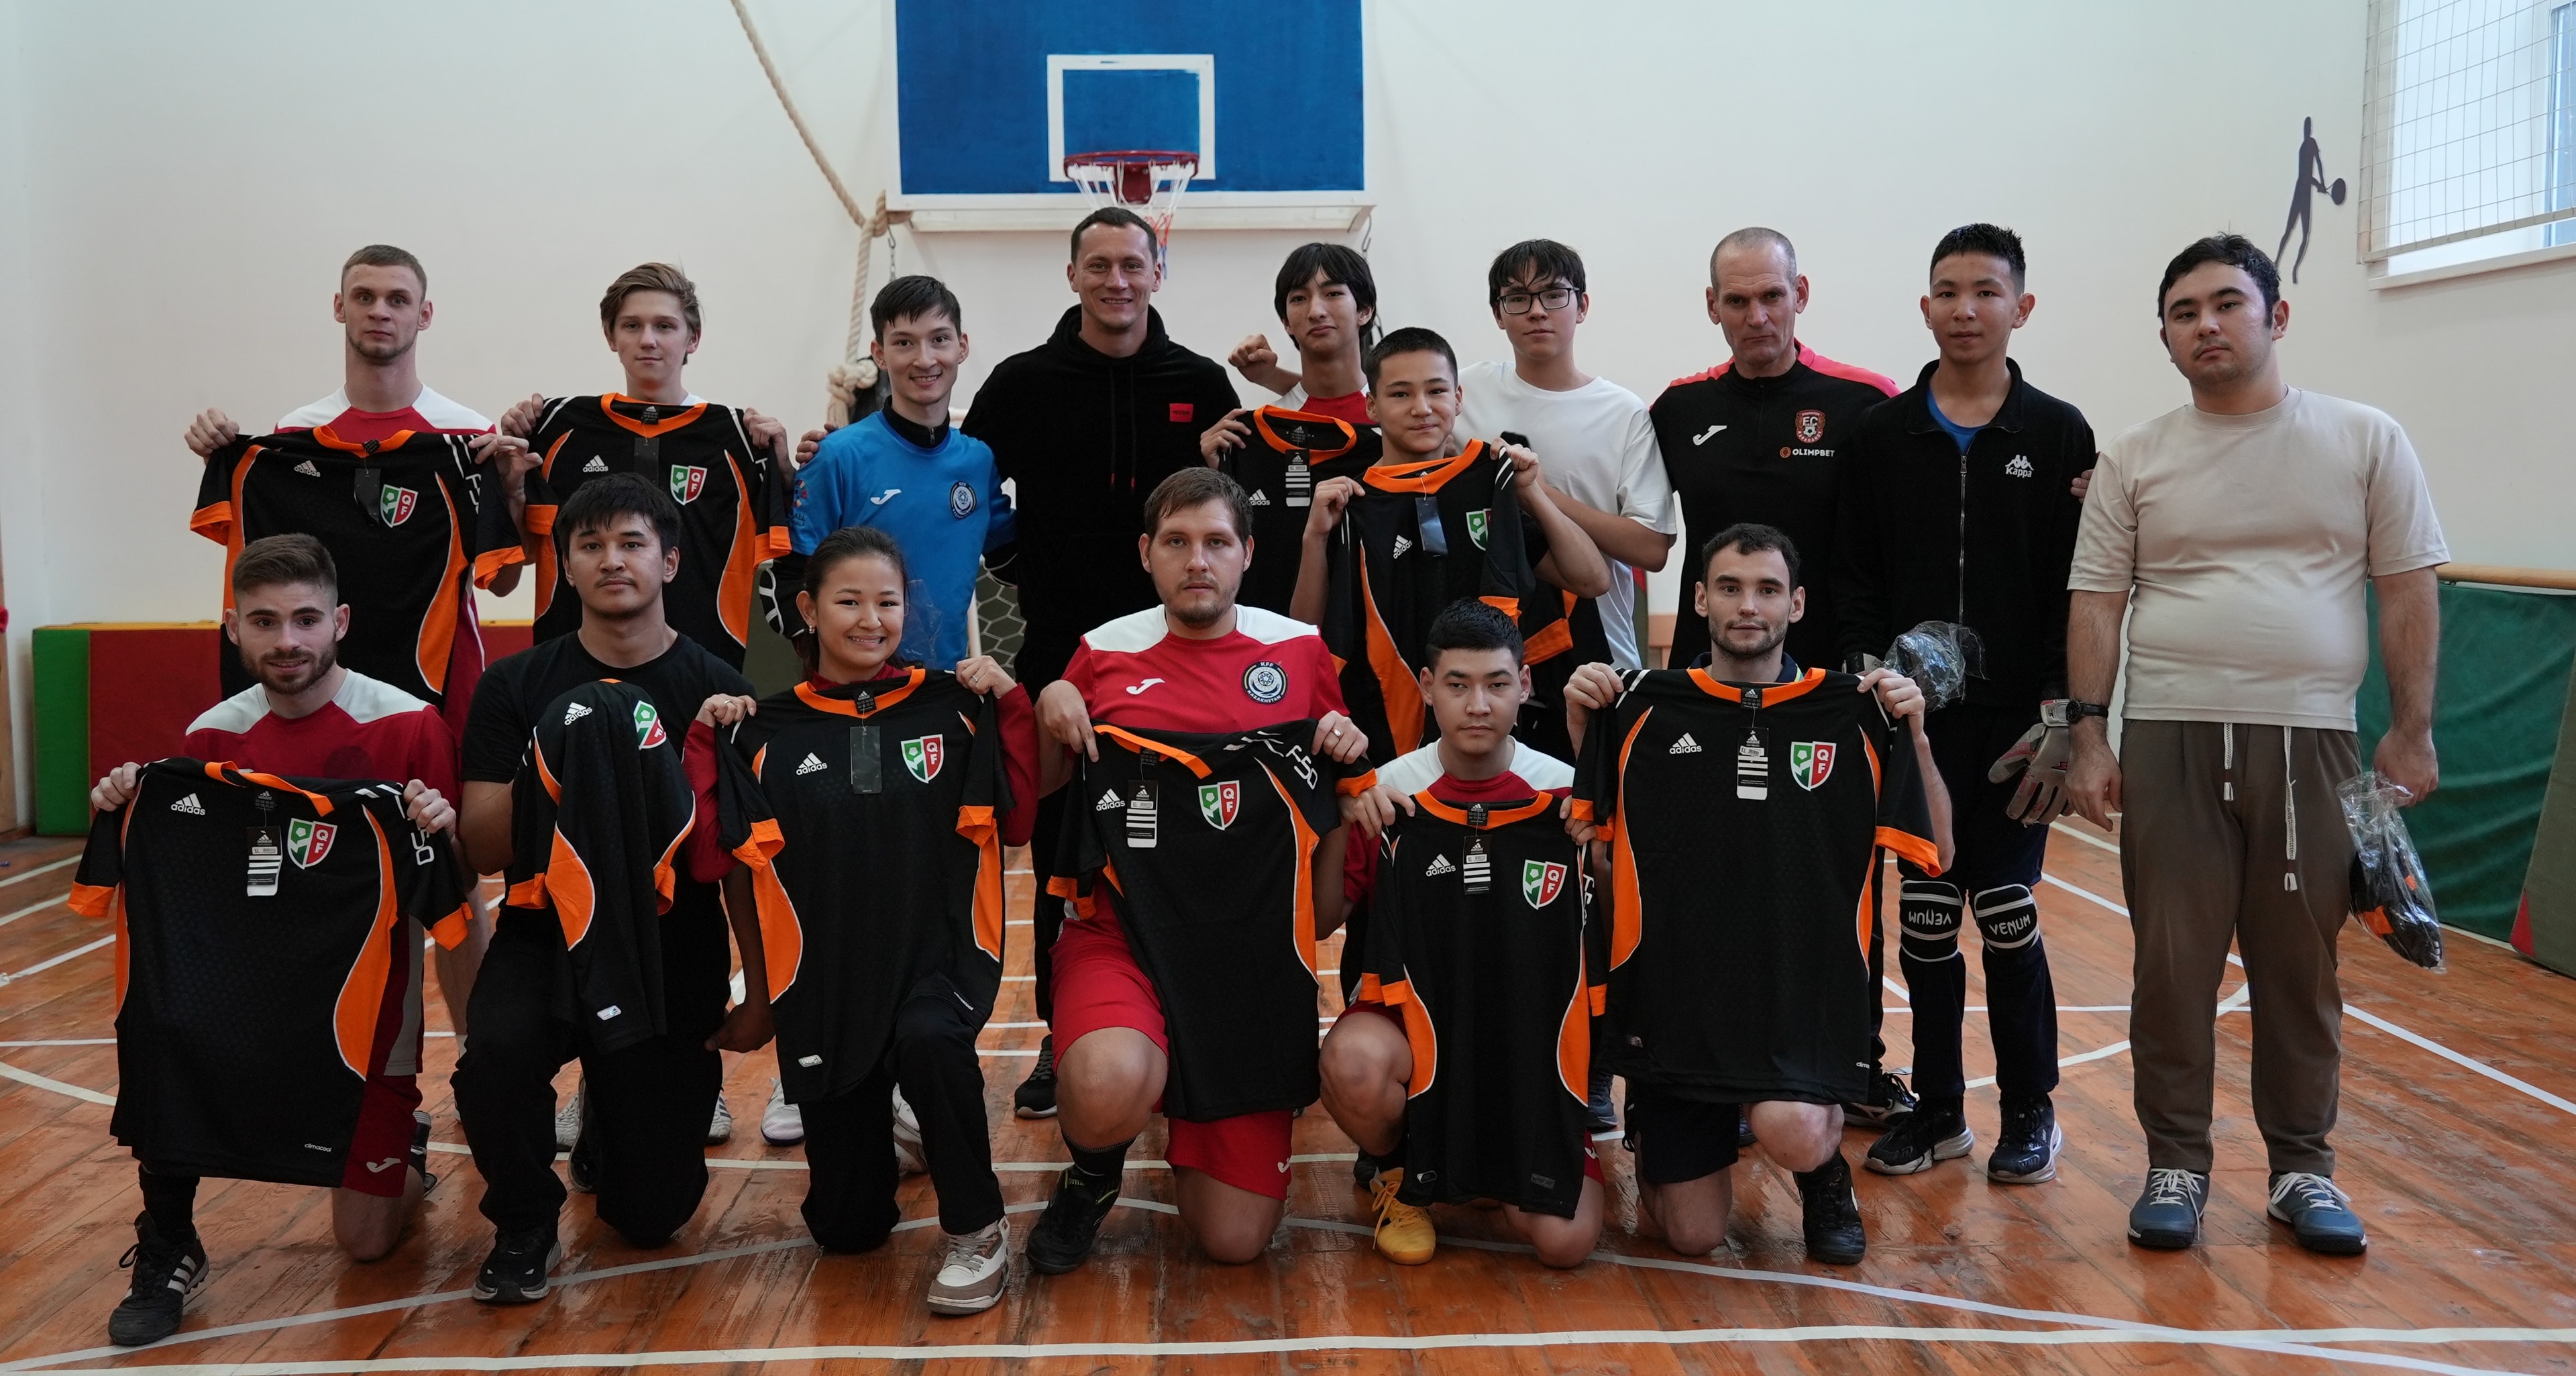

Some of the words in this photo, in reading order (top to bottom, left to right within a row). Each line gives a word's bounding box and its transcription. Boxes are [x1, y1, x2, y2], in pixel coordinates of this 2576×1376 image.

[1792, 448, 1835, 458] OLIMPBET
[294, 466, 321, 477] adidas
[582, 464, 609, 472] adidas
[2005, 466, 2032, 478] Kappa
[1393, 539, 1413, 559] adidas
[1247, 690, 1282, 704] KAZAKHSTAN
[564, 706, 593, 725] adidas
[1669, 745, 1702, 755] adidas
[796, 761, 828, 776] adidas
[1285, 745, 1318, 790] F50
[171, 804, 206, 816] adidas
[1096, 800, 1126, 812] adidas
[410, 827, 435, 865] 50
[1426, 865, 1456, 877] adidas
[1909, 908, 1952, 926] VENUM
[1989, 914, 2031, 936] VENUM
[305, 1143, 332, 1153] climacool
